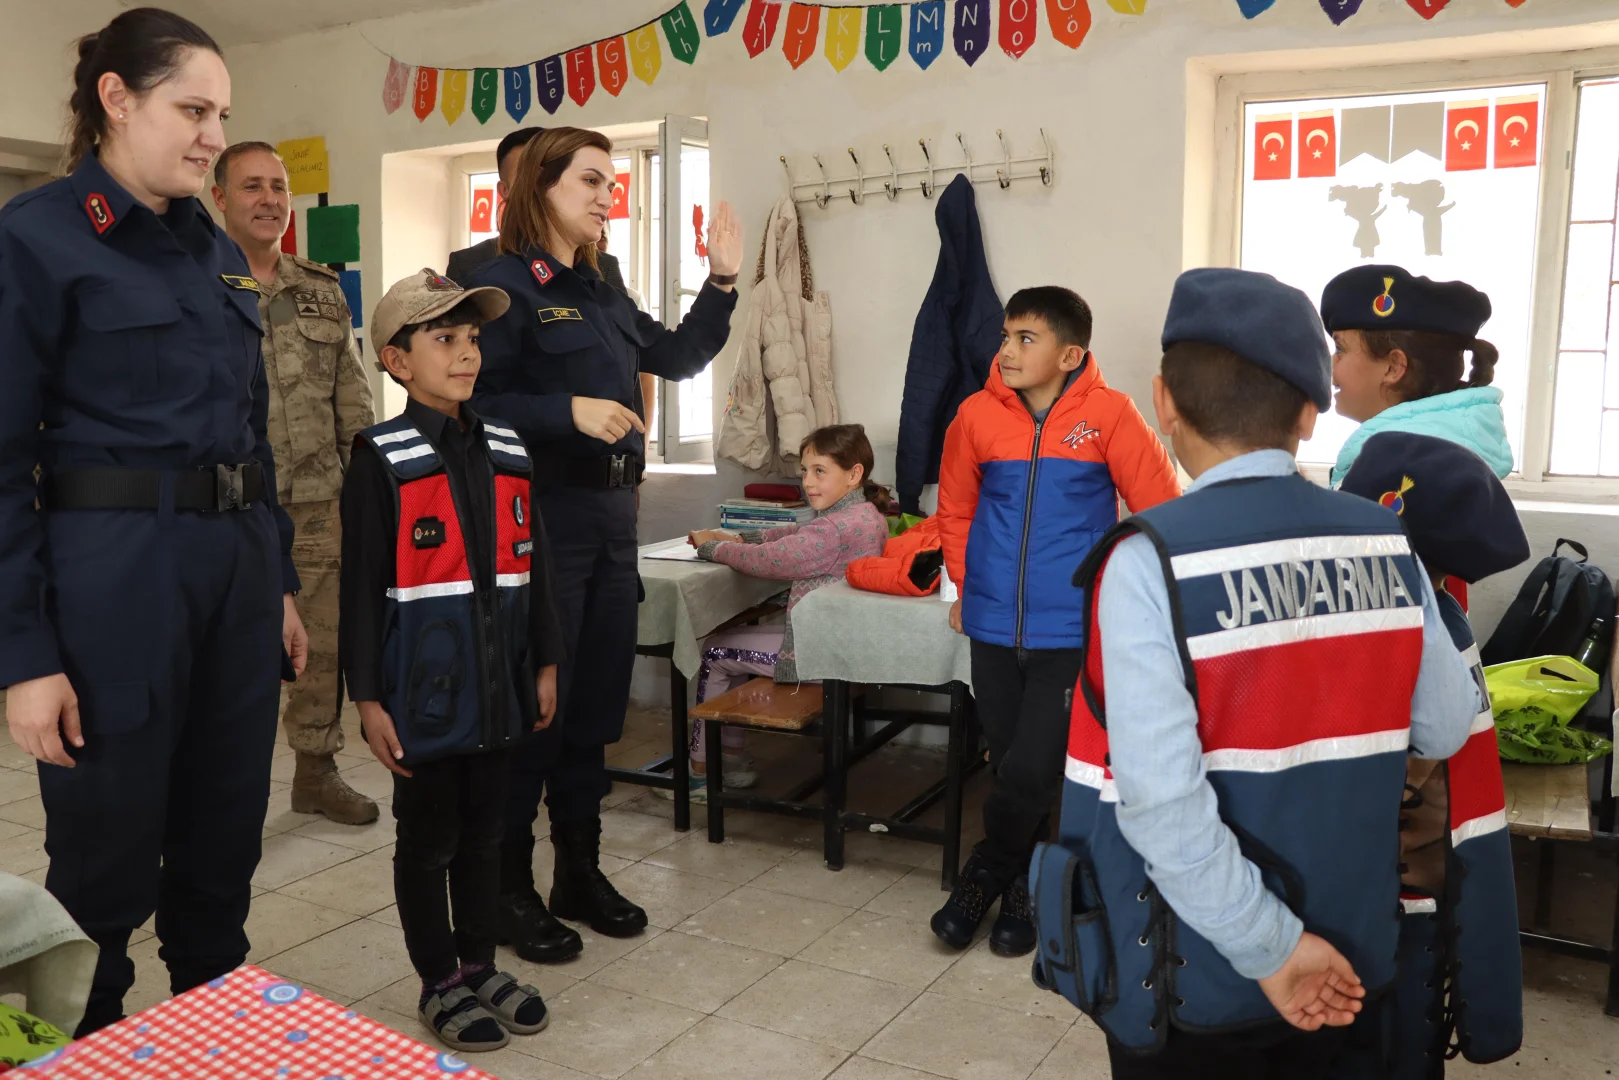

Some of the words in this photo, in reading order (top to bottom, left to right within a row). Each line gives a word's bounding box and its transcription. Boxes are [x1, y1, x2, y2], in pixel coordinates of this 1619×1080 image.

[420, 71, 429, 91] B
[451, 72, 459, 91] C
[513, 70, 522, 90] D
[545, 61, 556, 84] E
[575, 52, 585, 72] F
[604, 41, 619, 64] G
[670, 10, 686, 33] H
[797, 10, 811, 34] J
[838, 12, 850, 35] K
[878, 11, 891, 33] L
[917, 7, 938, 33] M
[962, 3, 978, 27] N
[420, 95, 426, 109] b
[515, 93, 521, 110] d
[549, 88, 556, 98] e
[579, 77, 585, 98] f
[680, 37, 692, 54] h
[794, 40, 803, 62] j
[917, 42, 931, 54] m
[964, 39, 974, 52] n
[1067, 15, 1078, 33] ö
[1216, 556, 1415, 629] JANDARMA
